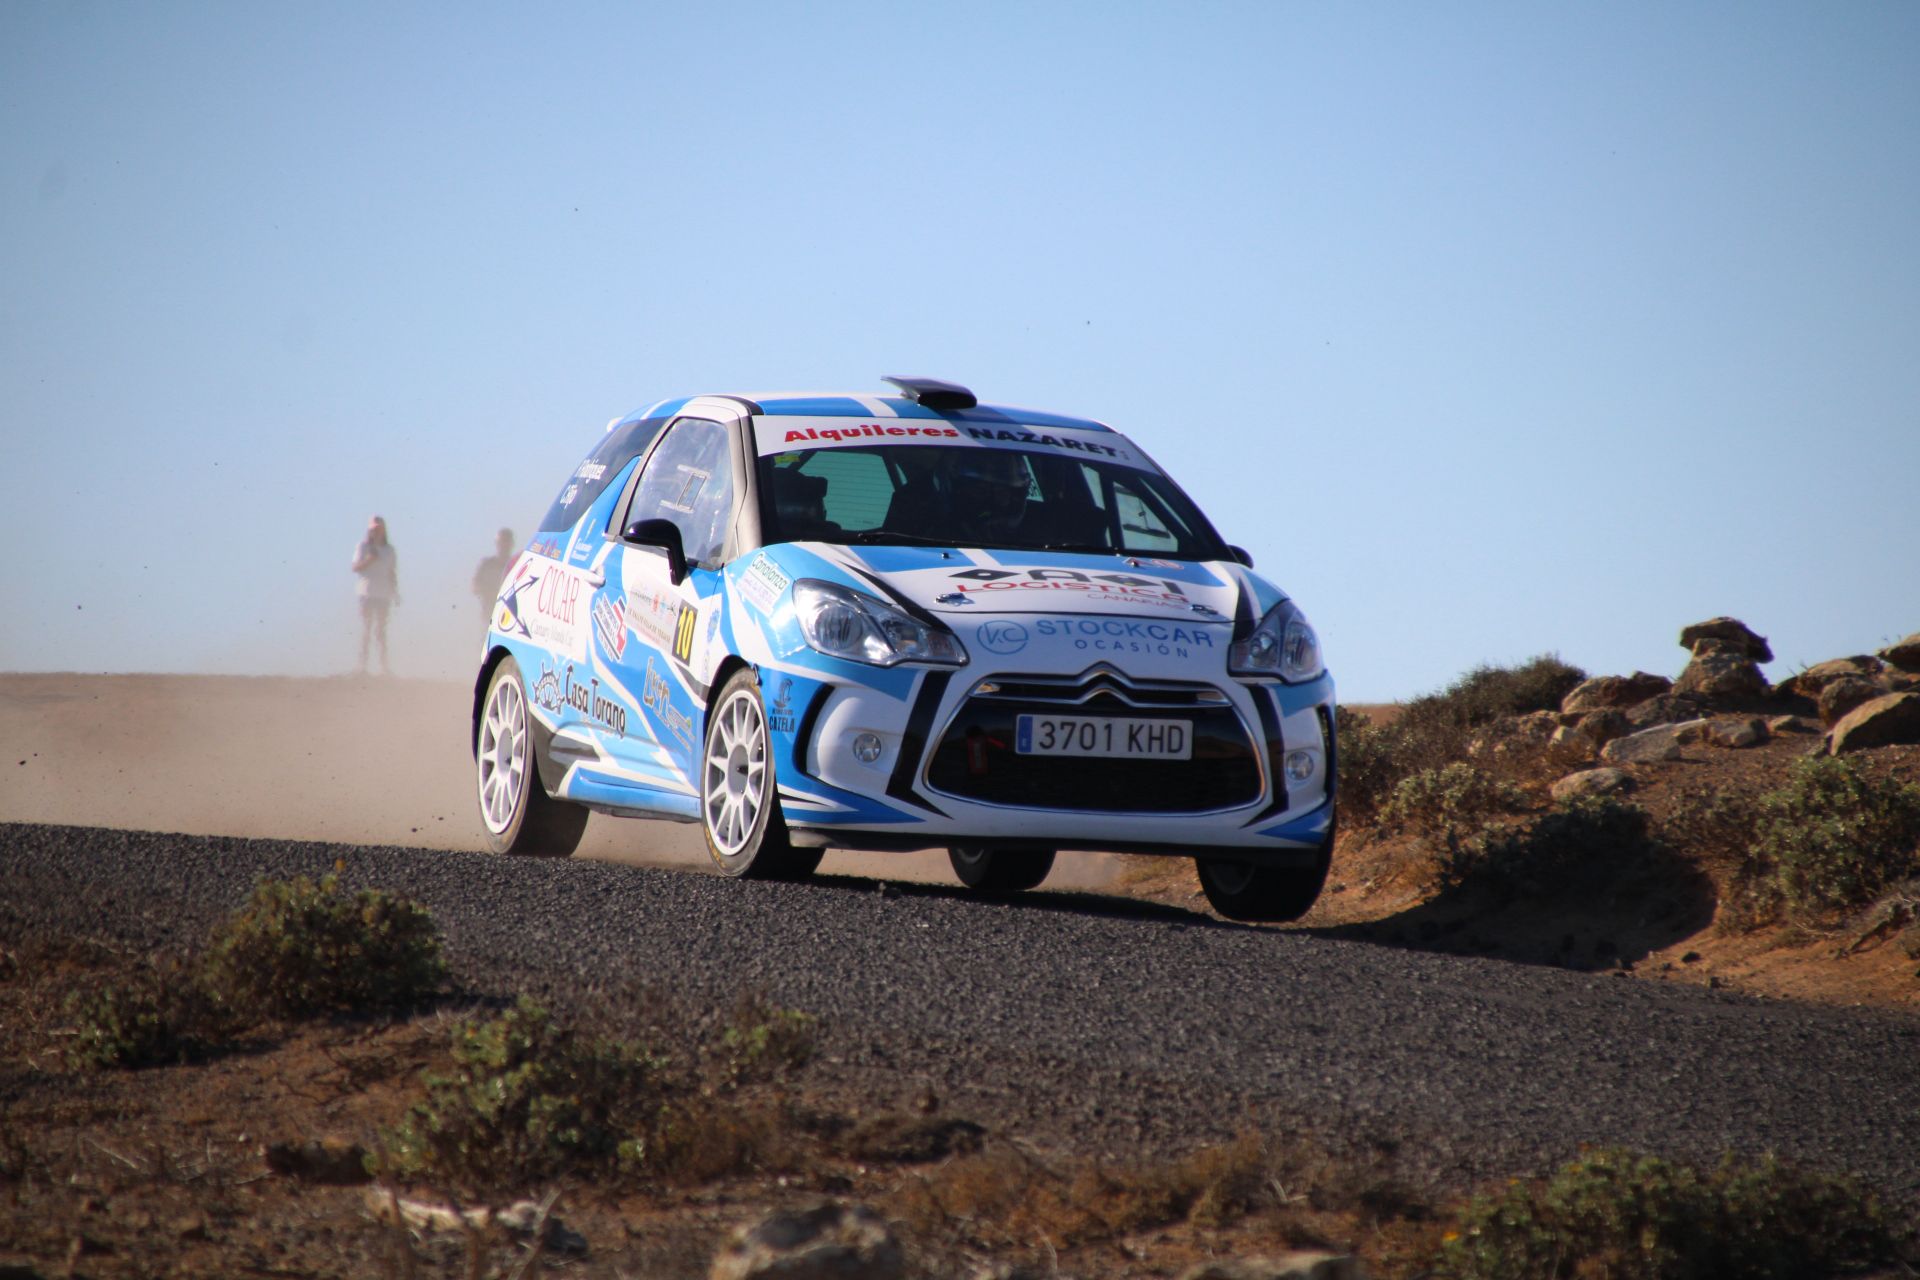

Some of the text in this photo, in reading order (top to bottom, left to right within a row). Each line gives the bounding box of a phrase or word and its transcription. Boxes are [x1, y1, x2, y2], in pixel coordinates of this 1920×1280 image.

[785, 424, 959, 442] Alquileres
[967, 427, 1117, 457] NAZARET
[538, 565, 580, 626] CICAR
[676, 606, 695, 660] 10
[1036, 619, 1214, 648] STOCKCAR
[565, 664, 589, 715] Casa
[1039, 721, 1184, 753] 3701 KHD
